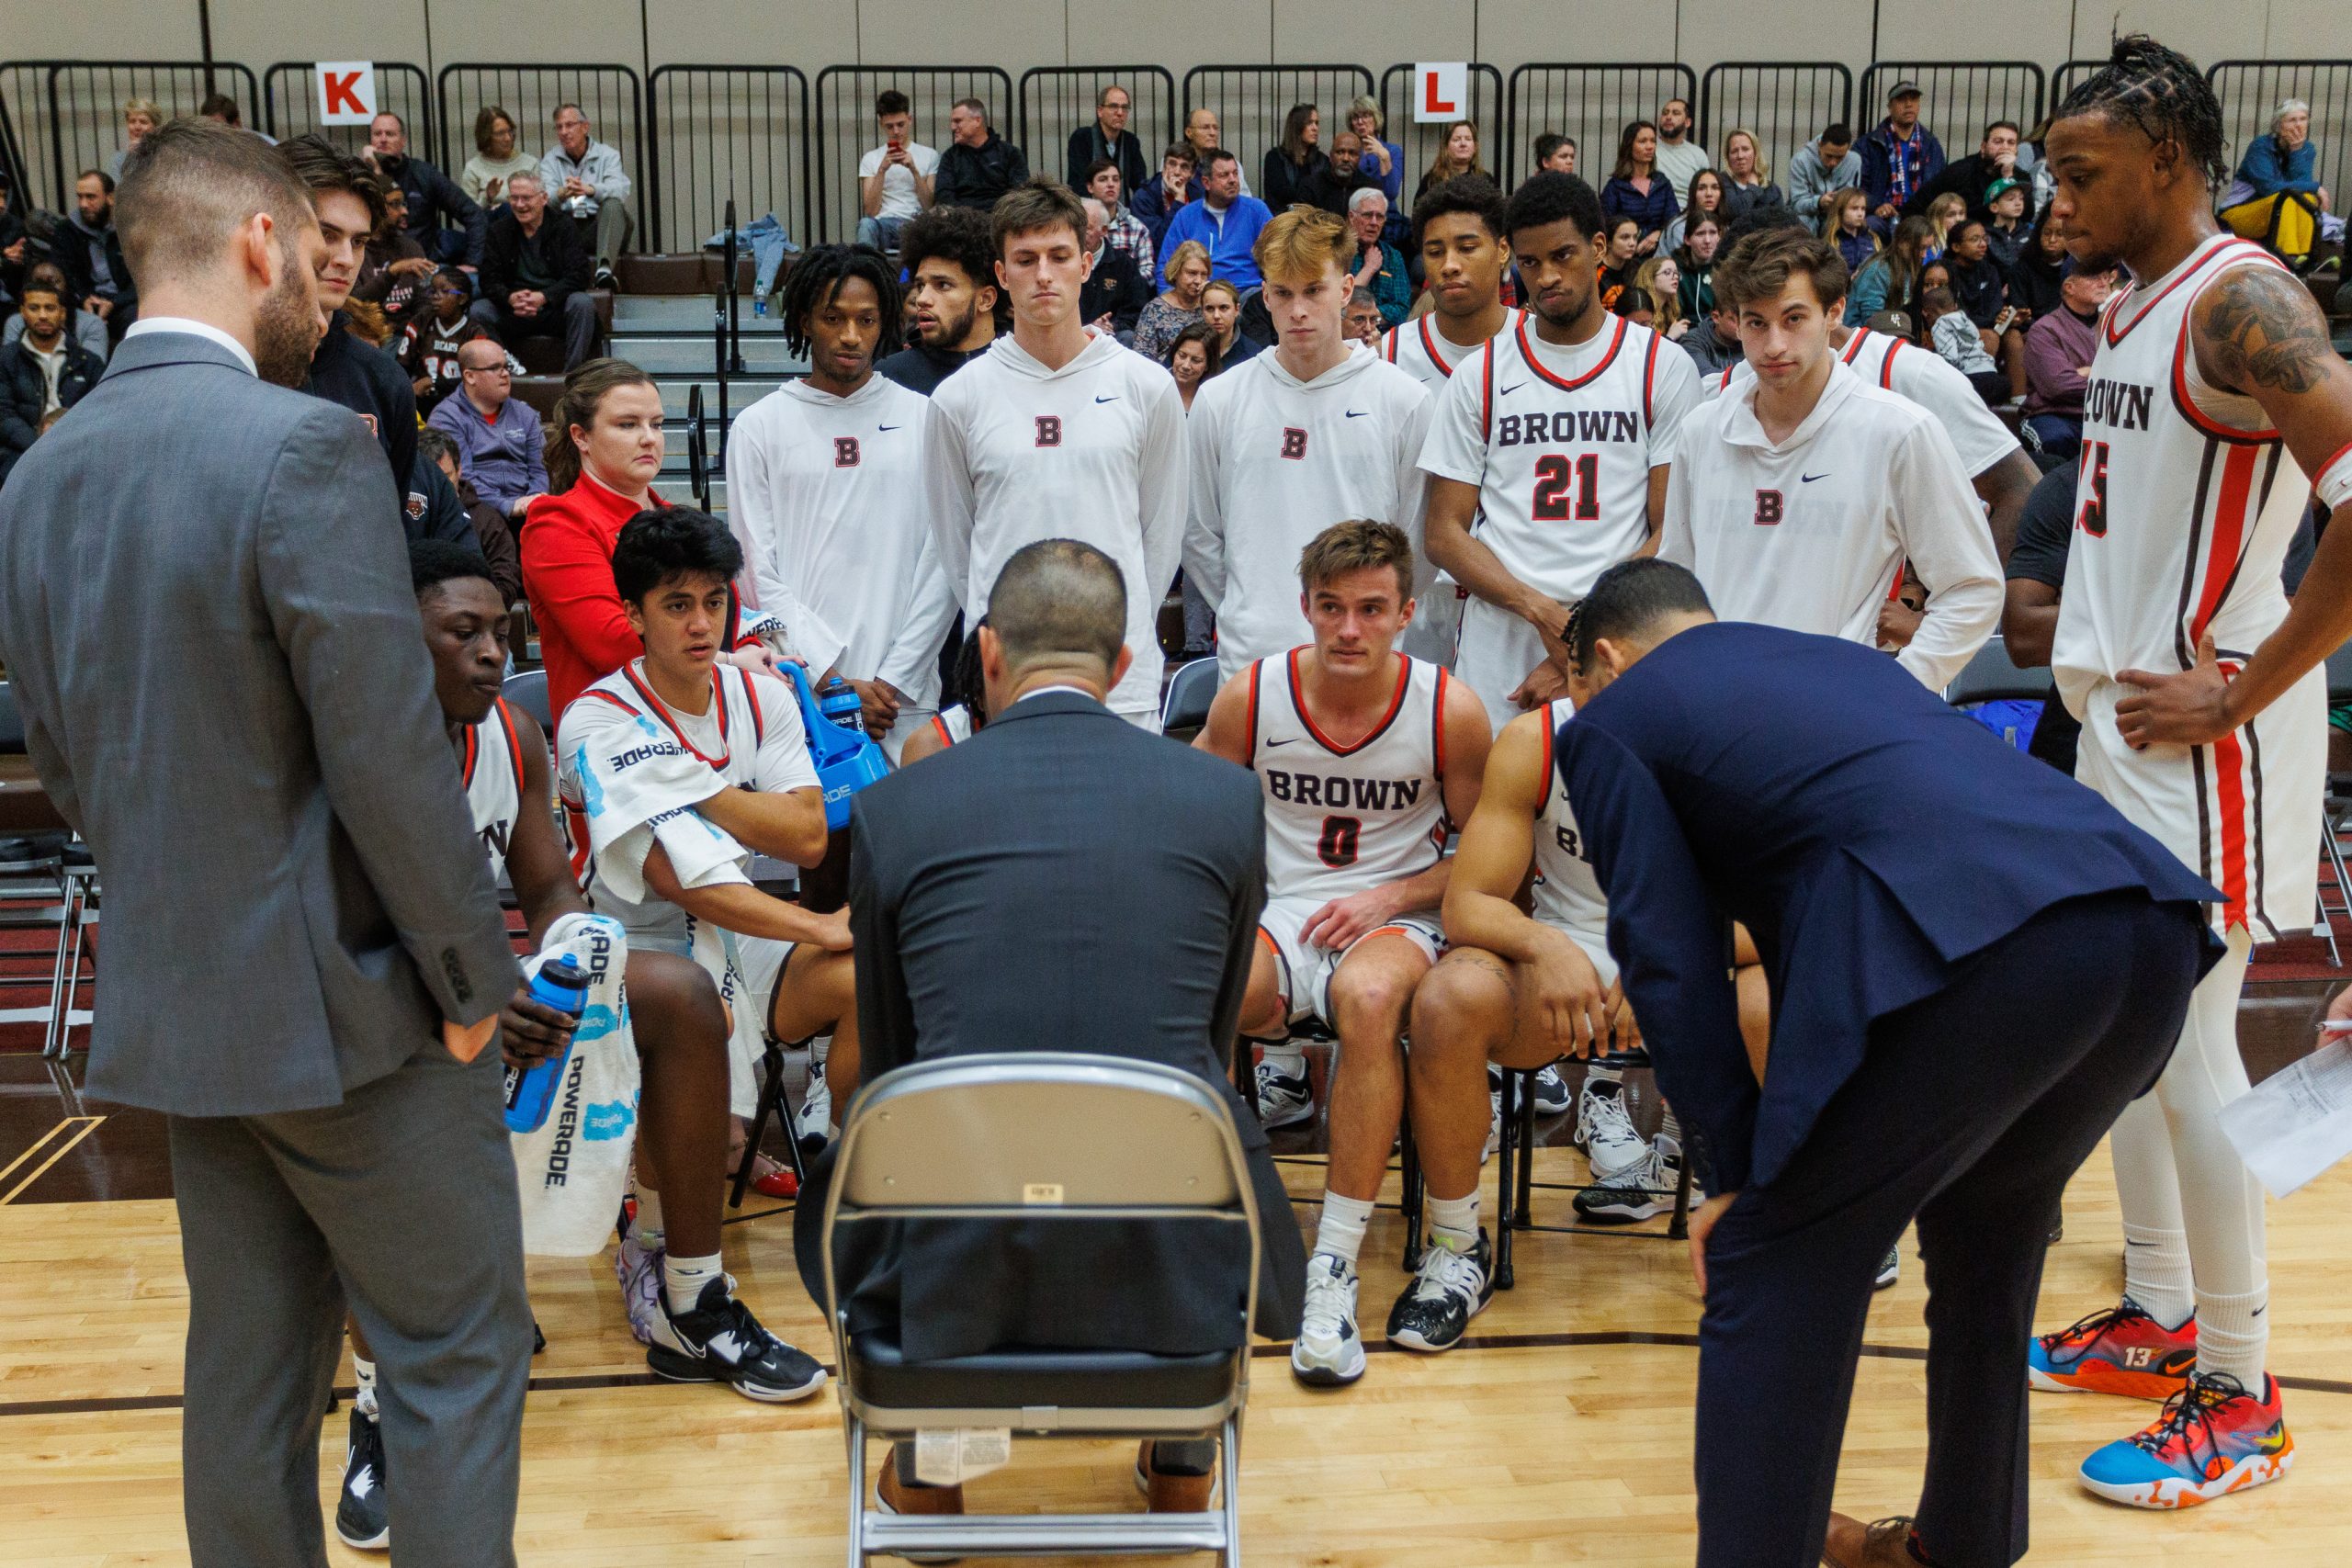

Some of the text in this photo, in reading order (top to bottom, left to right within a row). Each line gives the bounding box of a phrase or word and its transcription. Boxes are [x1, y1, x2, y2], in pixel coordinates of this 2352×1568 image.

[323, 72, 369, 115] K
[1426, 72, 1455, 113] L
[1035, 415, 1061, 447] B
[1281, 427, 1308, 460] B
[1498, 411, 1638, 447] BROWN
[833, 436, 860, 468] B
[1532, 453, 1600, 521] 21
[1754, 489, 1783, 525] B
[1267, 769, 1421, 810] BROWN
[1317, 815, 1362, 868] 0
[544, 1055, 584, 1189] POWERADE
[2125, 1346, 2152, 1368] 13
